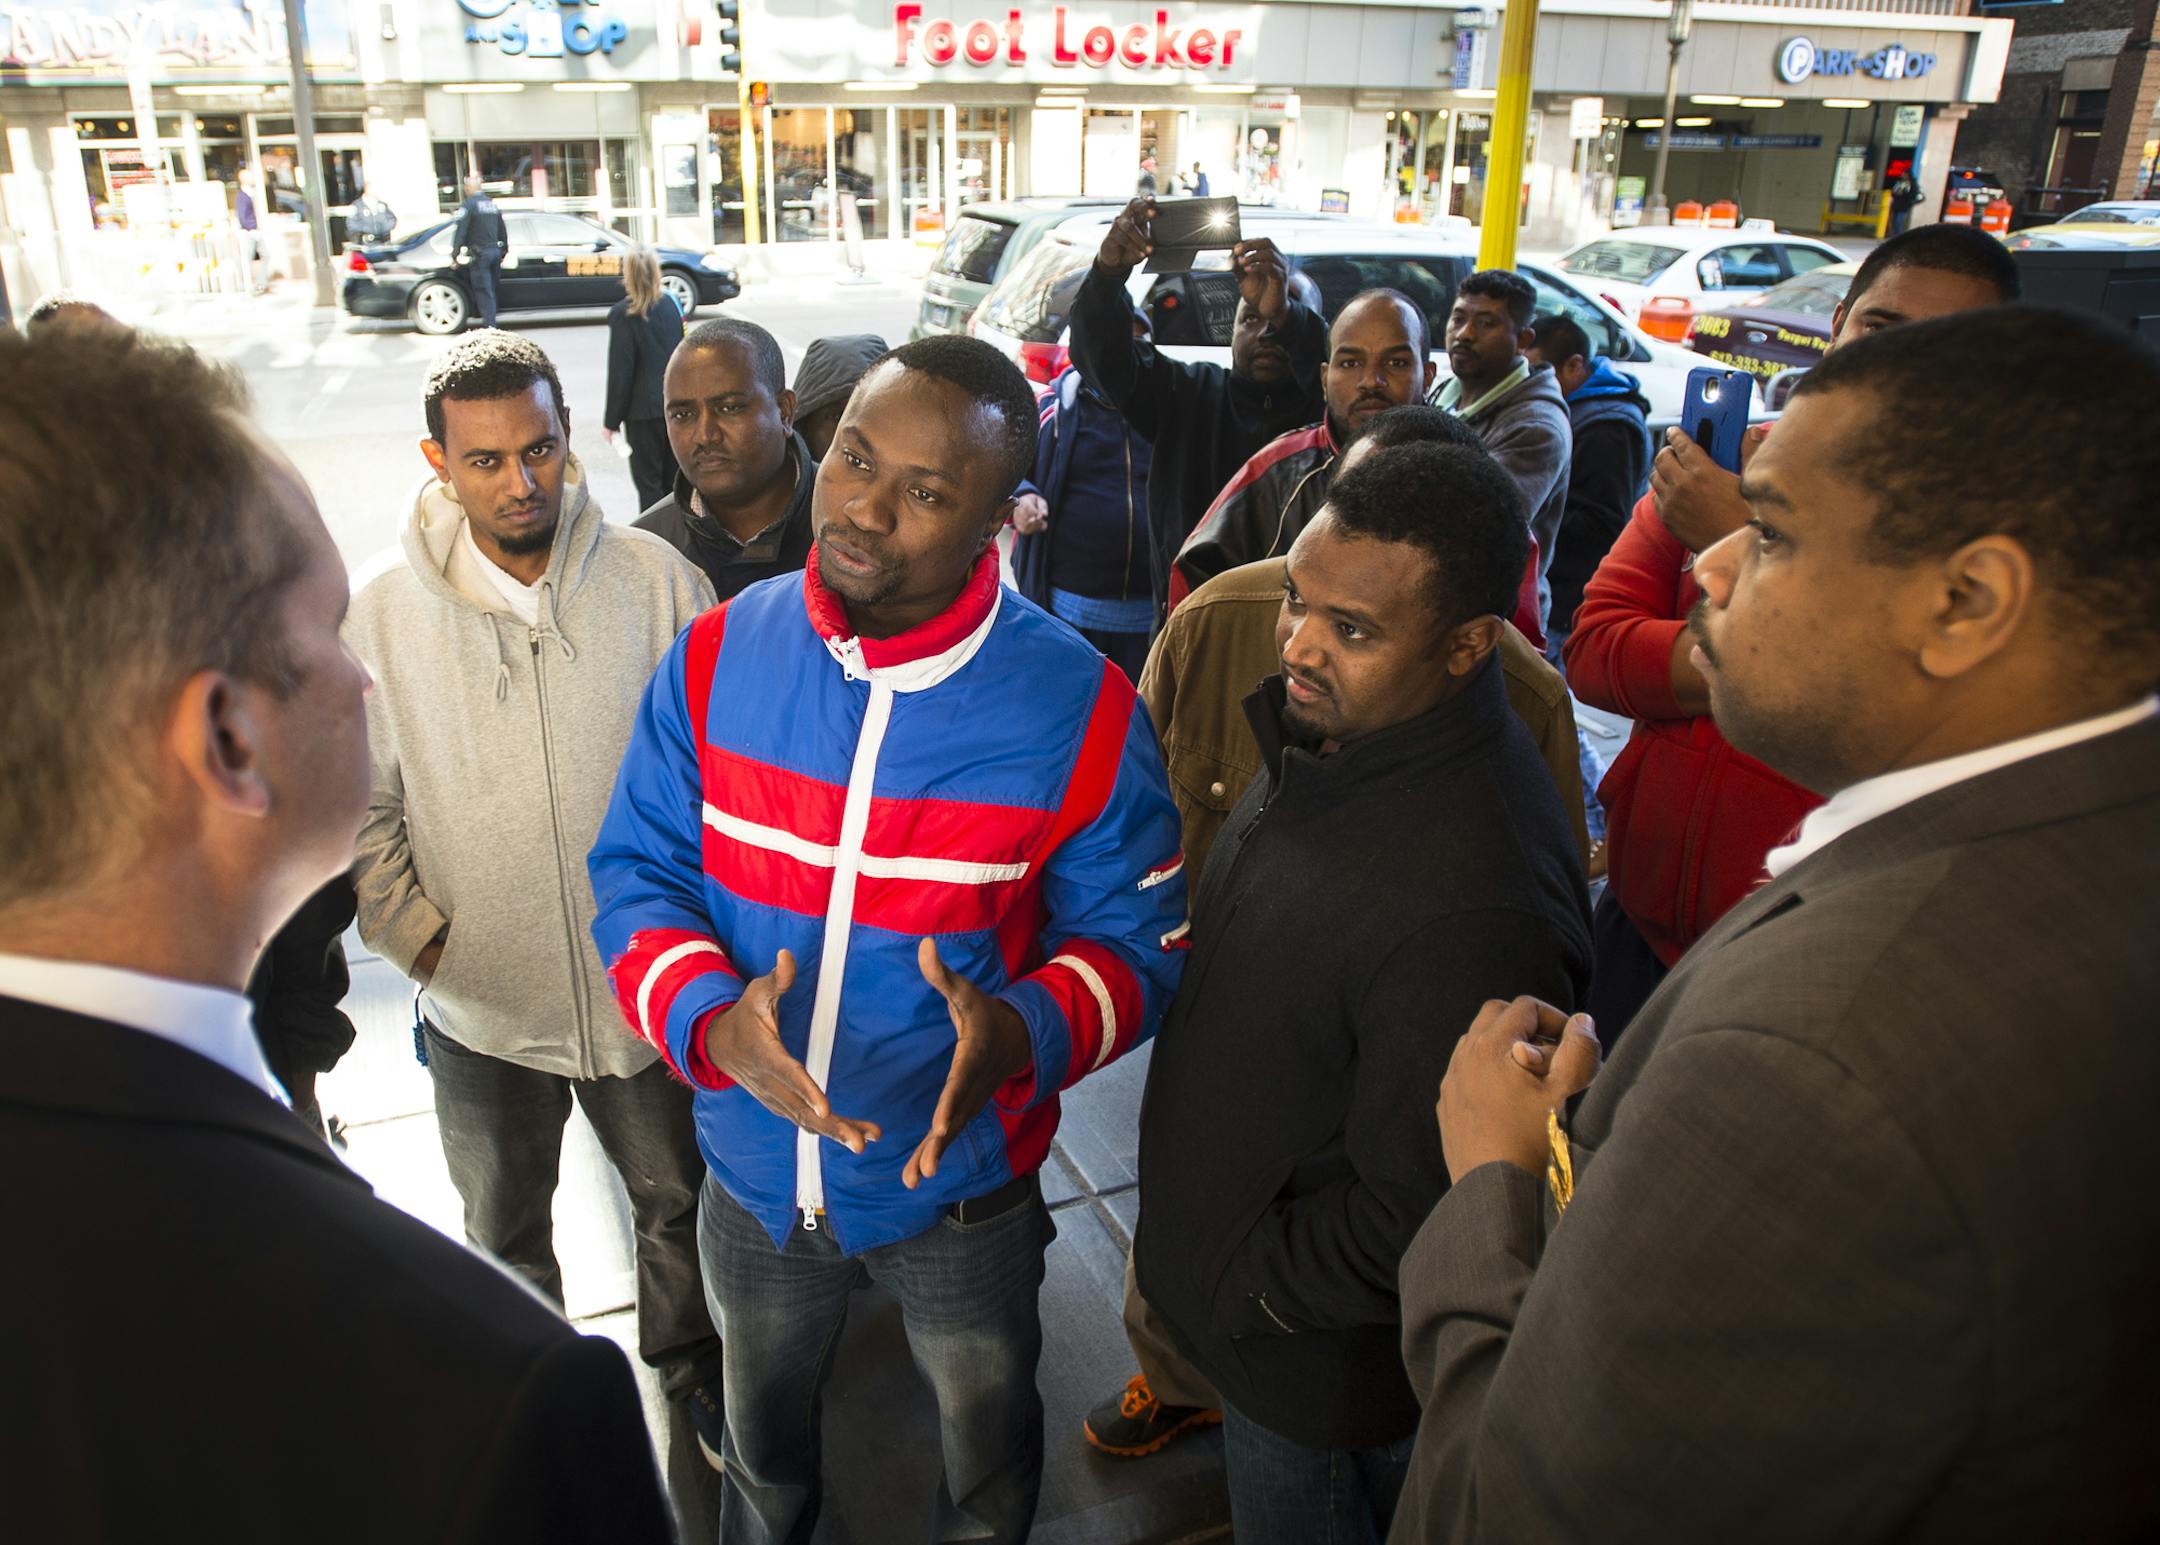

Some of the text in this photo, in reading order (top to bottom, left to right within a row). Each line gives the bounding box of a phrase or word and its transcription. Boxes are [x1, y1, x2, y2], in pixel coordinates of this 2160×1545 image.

[894, 3, 1242, 70] Foot Locker
[1781, 37, 1857, 83] PARK
[1871, 47, 1937, 80] SHOP
